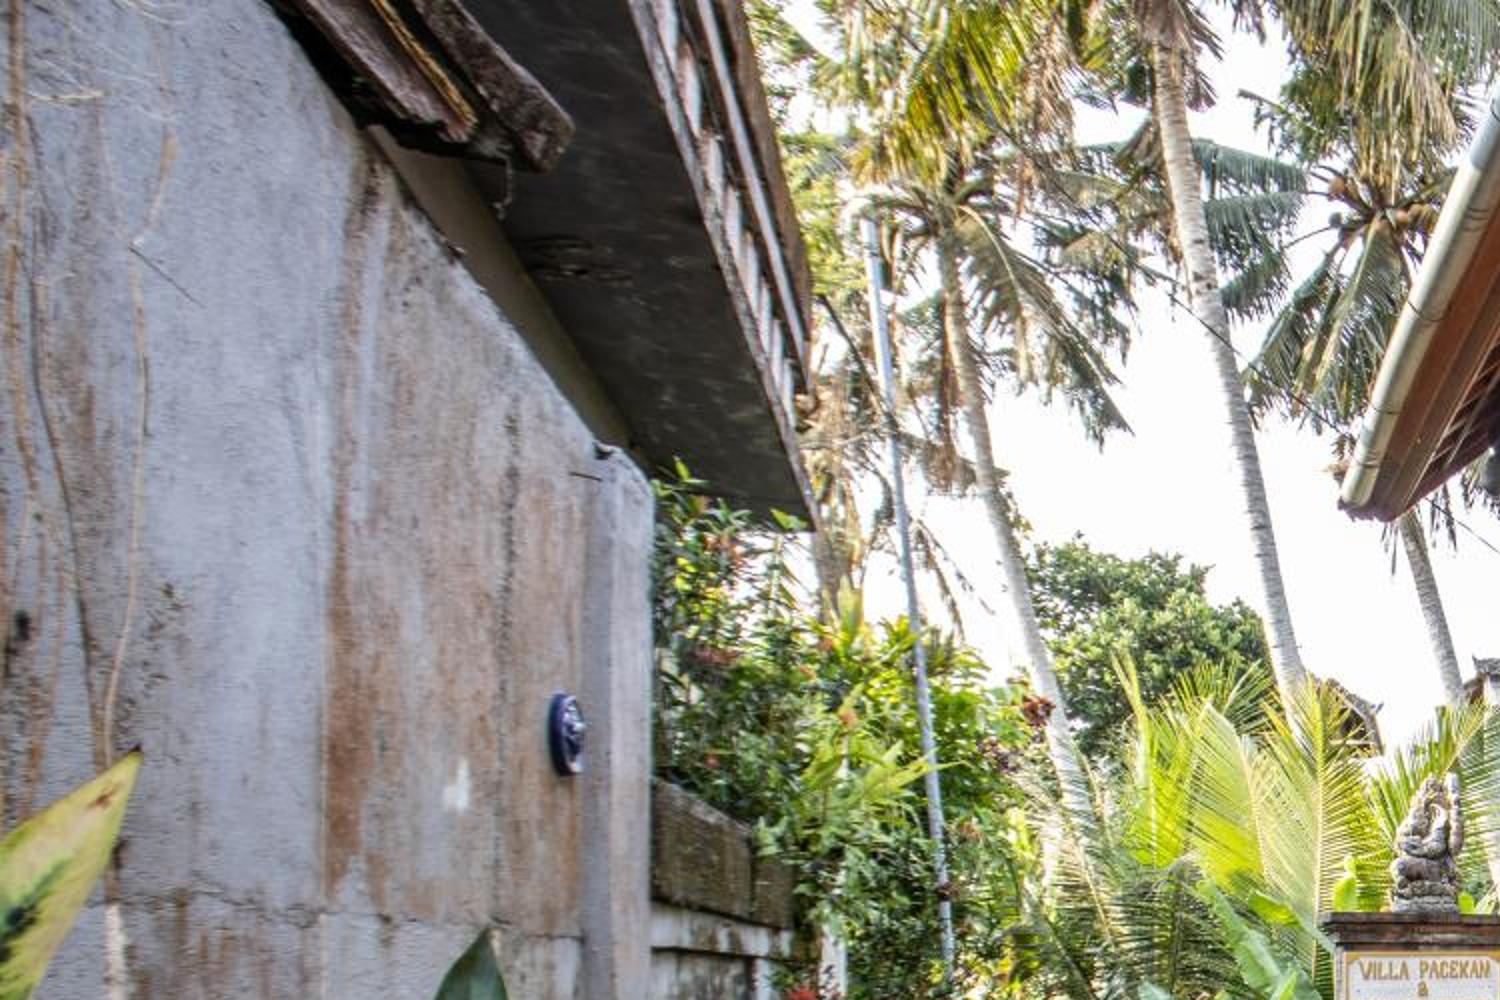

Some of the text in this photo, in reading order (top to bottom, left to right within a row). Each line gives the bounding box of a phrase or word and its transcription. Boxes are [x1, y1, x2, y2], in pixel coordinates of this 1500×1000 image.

[1359, 959, 1491, 980] VILLA PACEKAN
[1417, 981, 1429, 997] &
